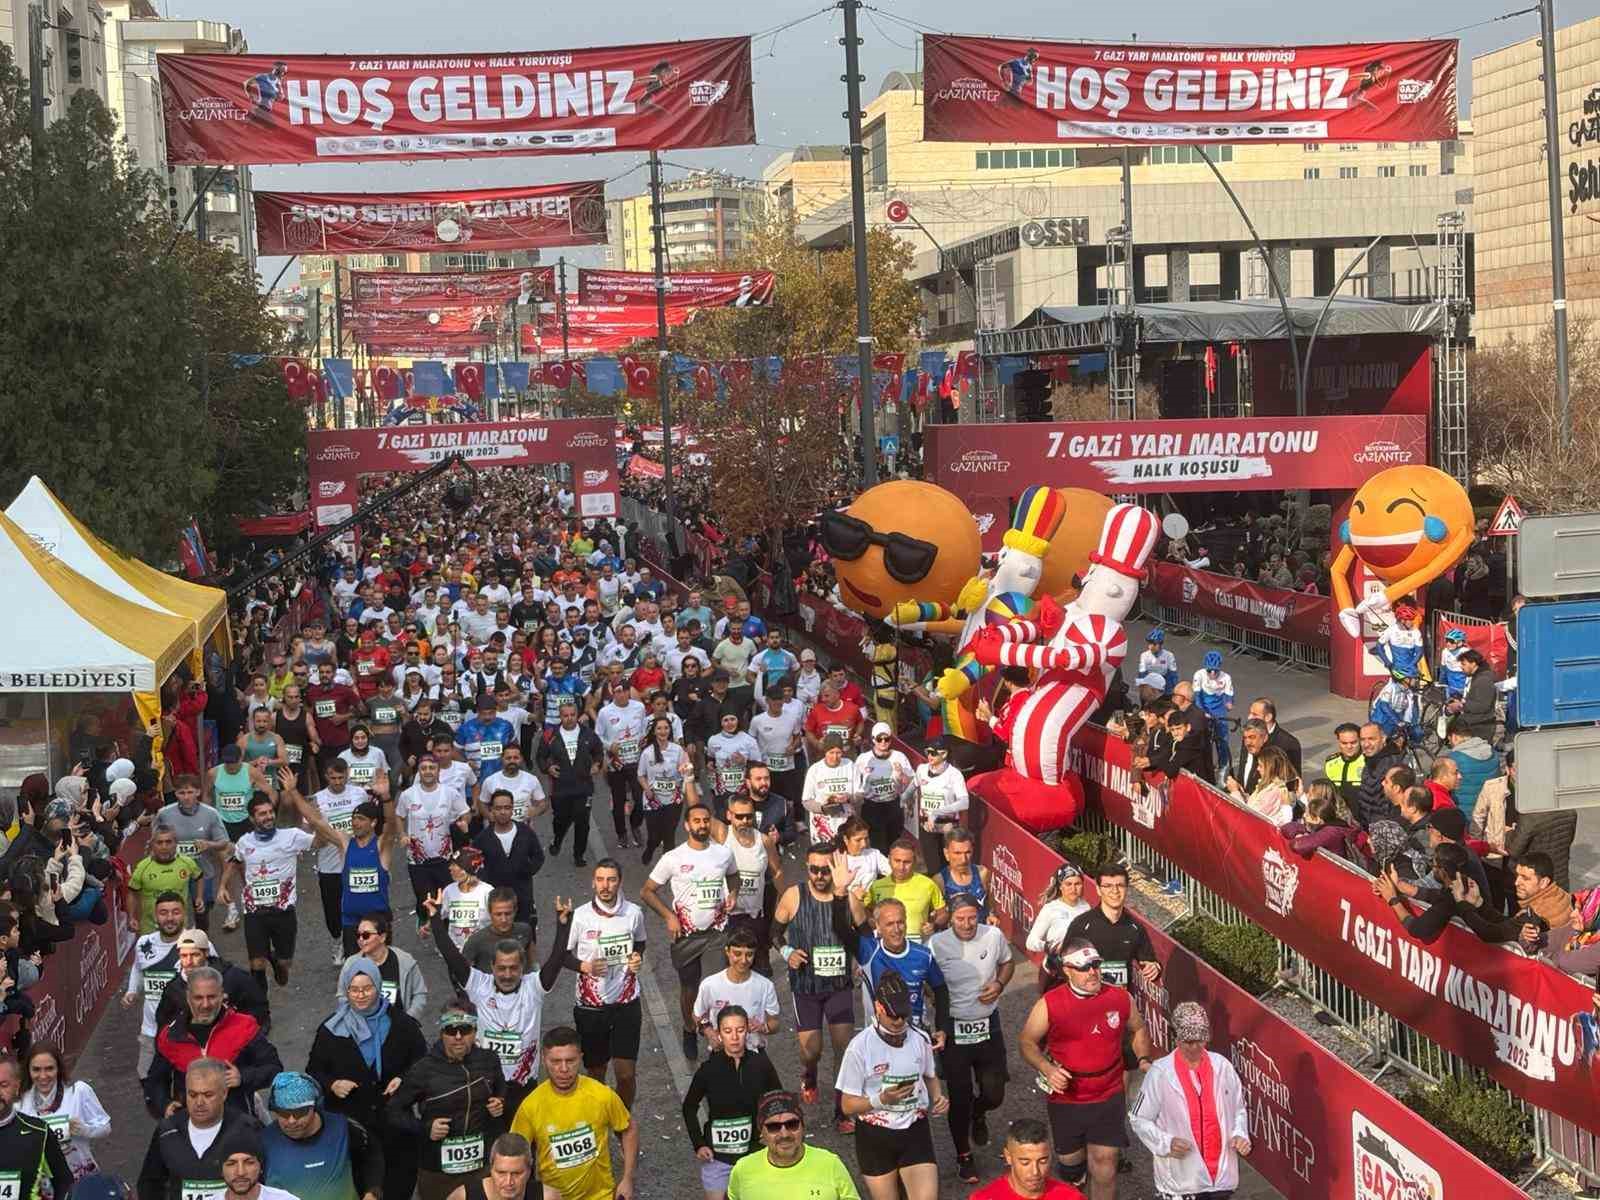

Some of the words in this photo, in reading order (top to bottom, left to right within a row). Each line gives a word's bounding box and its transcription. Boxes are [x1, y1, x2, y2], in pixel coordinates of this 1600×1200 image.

[412, 57, 471, 70] MARATONU
[489, 57, 516, 68] HALK
[1152, 50, 1204, 62] MARATONU
[1220, 51, 1244, 62] HALK
[1036, 66, 1131, 118] HOŞ
[286, 77, 394, 131] HOŞ
[291, 204, 360, 224] SPOR
[429, 431, 463, 447] YARI
[467, 427, 549, 444] MARATONU
[1130, 432, 1183, 455] YARI
[1189, 430, 1319, 455] MARATONU
[430, 449, 442, 458] 30
[477, 446, 499, 457] 2025
[1133, 462, 1172, 479] HALK
[1179, 459, 1240, 479] KOŞUSU
[11, 668, 137, 687] BELEDİYESİ
[255, 886, 278, 897] 1498
[604, 944, 628, 956] 1621
[816, 956, 843, 967] 1324
[1397, 936, 1441, 996] YARI
[1444, 964, 1575, 1066] MARATONU
[958, 1022, 986, 1035] 1052
[488, 1042, 515, 1055] 1212
[1506, 1042, 1528, 1069] 2025
[716, 1128, 749, 1143] 1290
[446, 1144, 480, 1162] 1033
[555, 1137, 593, 1158] 1068
